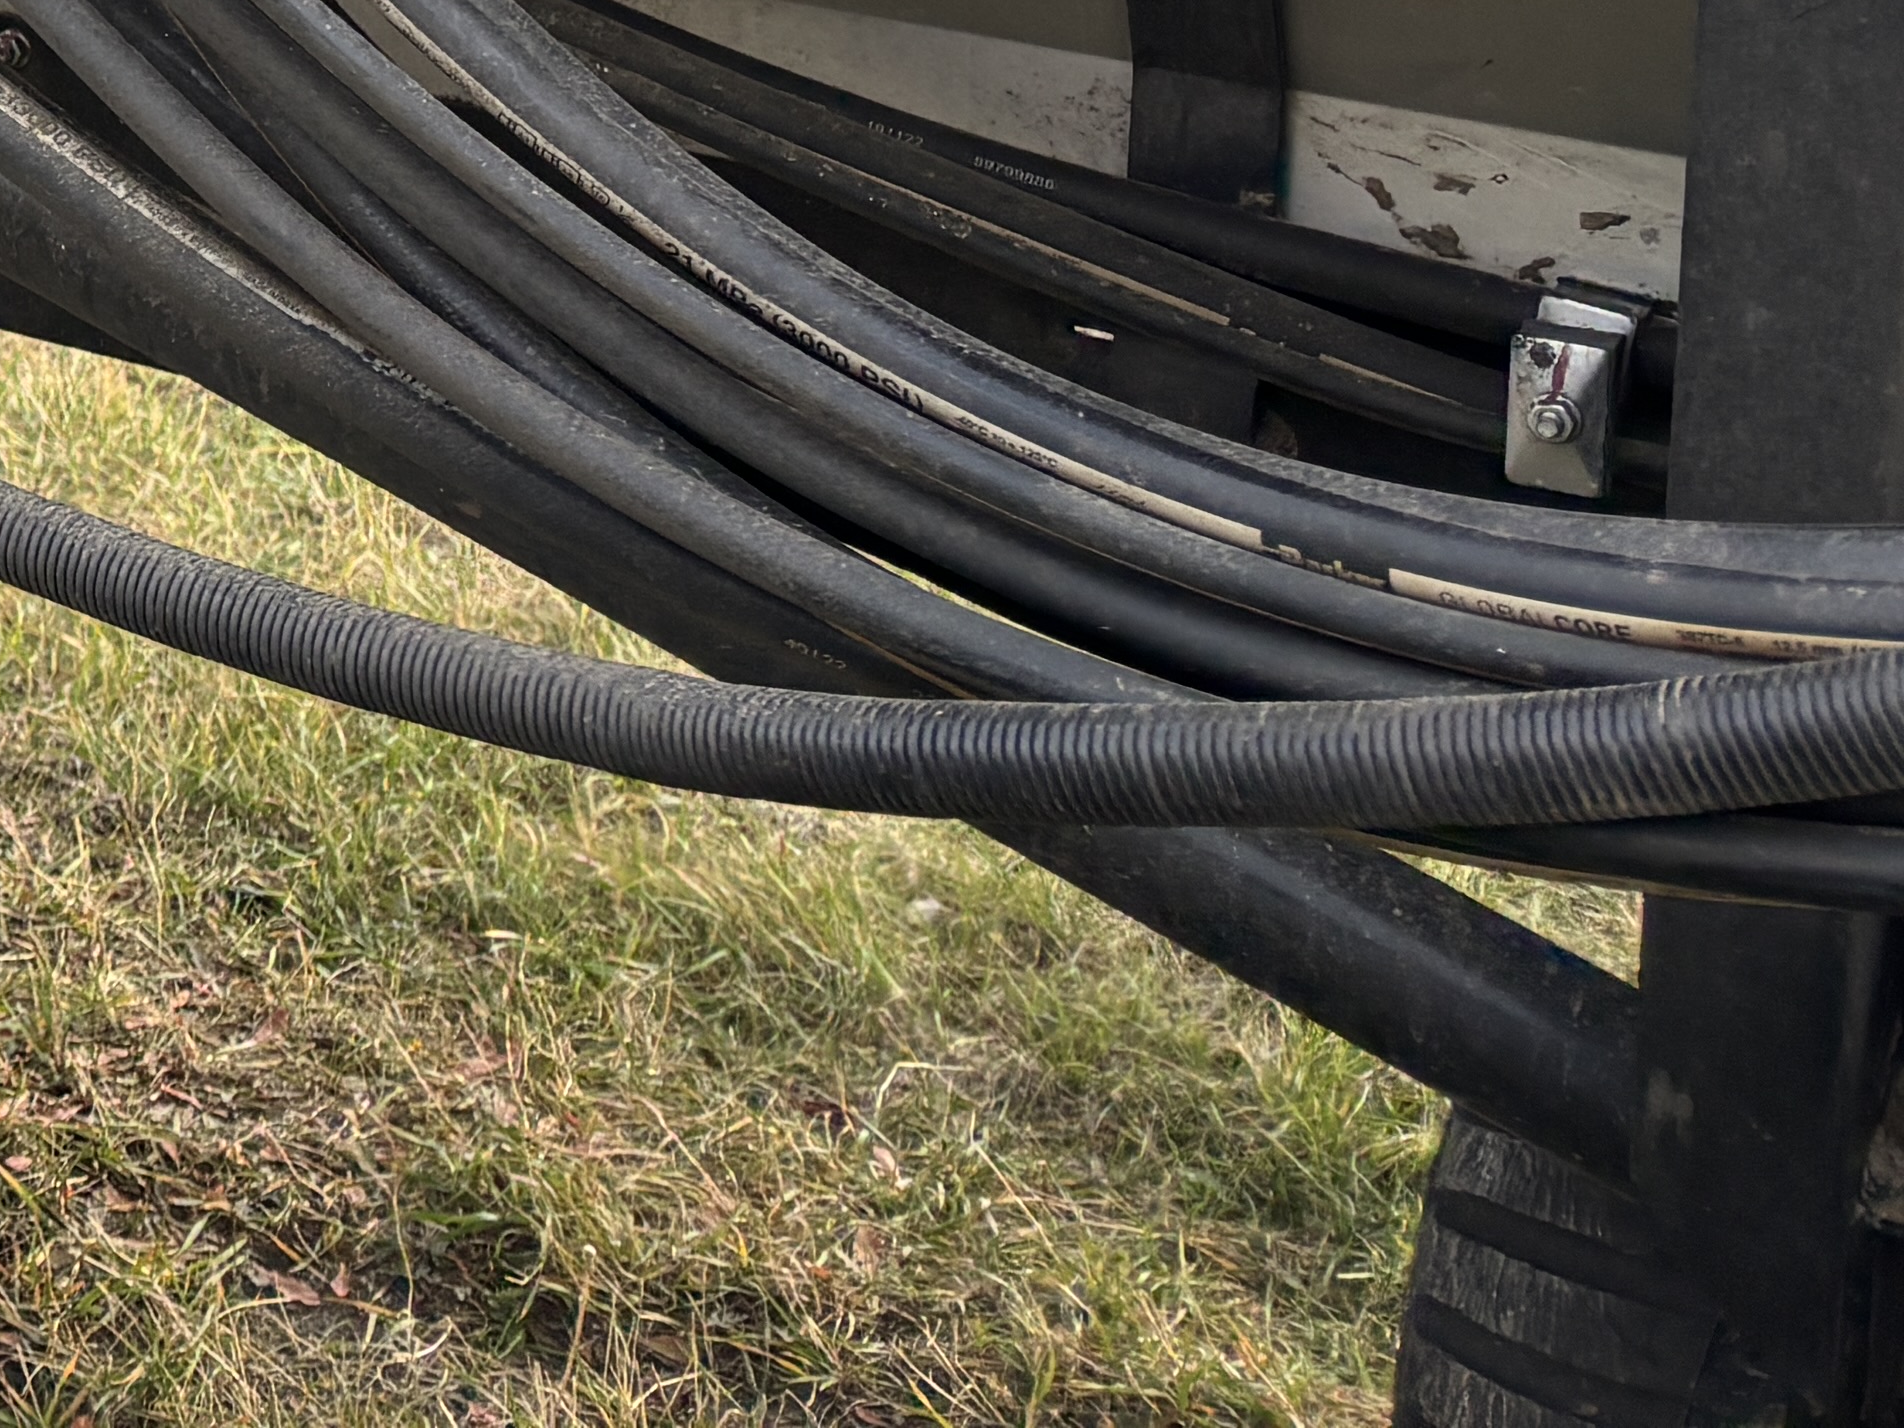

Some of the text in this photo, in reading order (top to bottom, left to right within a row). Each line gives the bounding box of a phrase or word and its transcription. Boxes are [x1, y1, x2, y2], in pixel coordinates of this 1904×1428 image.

[663, 241, 924, 413] 21 MPa (3000 PSI)
